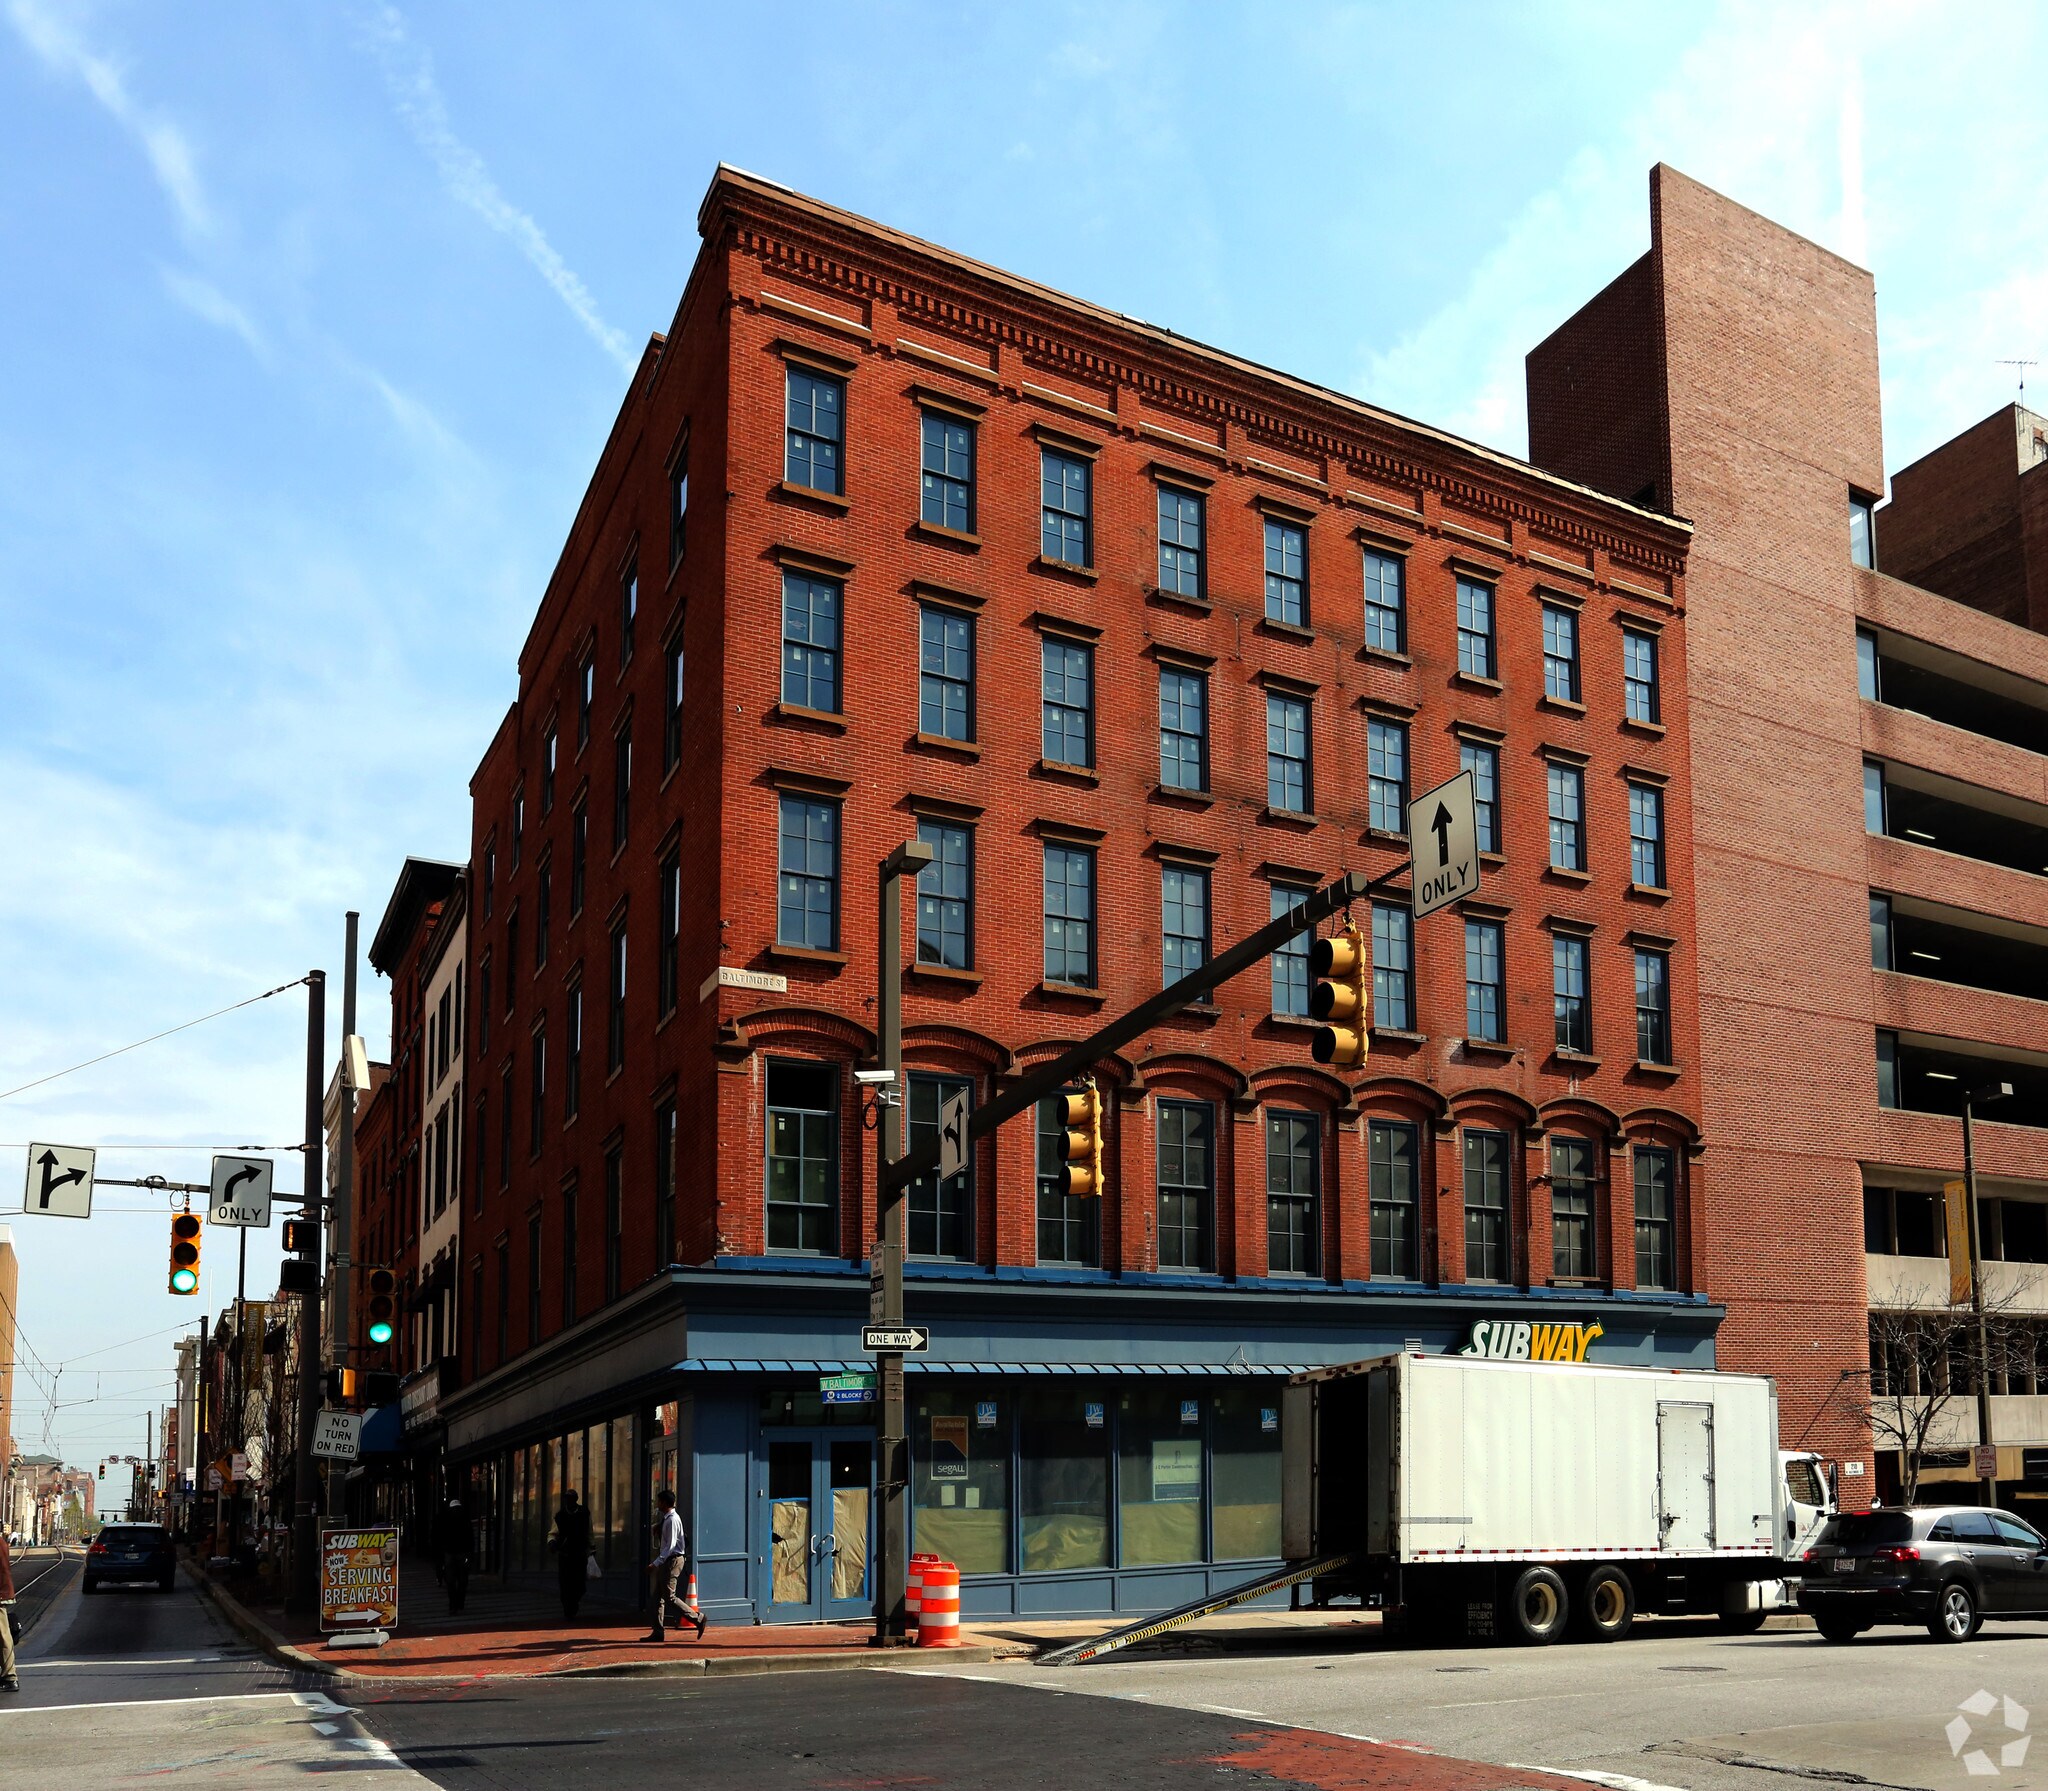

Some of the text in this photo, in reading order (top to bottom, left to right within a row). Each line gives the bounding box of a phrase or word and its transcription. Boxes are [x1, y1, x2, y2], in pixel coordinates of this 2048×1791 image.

[1422, 861, 1469, 904] ONLY
[722, 972, 773, 986] BALTIMORE
[218, 1206, 262, 1221] ONLY
[869, 1334, 913, 1344] ONE WAY
[1463, 1319, 1605, 1362] SUBWAY
[331, 1417, 349, 1428] NO
[325, 1429, 352, 1441] TURN
[317, 1441, 355, 1453] ON RED
[325, 1532, 395, 1550] SUBWAY
[329, 1556, 344, 1566] NOW
[329, 1567, 392, 1586] SERVING
[324, 1586, 395, 1604] BREAKFAST
